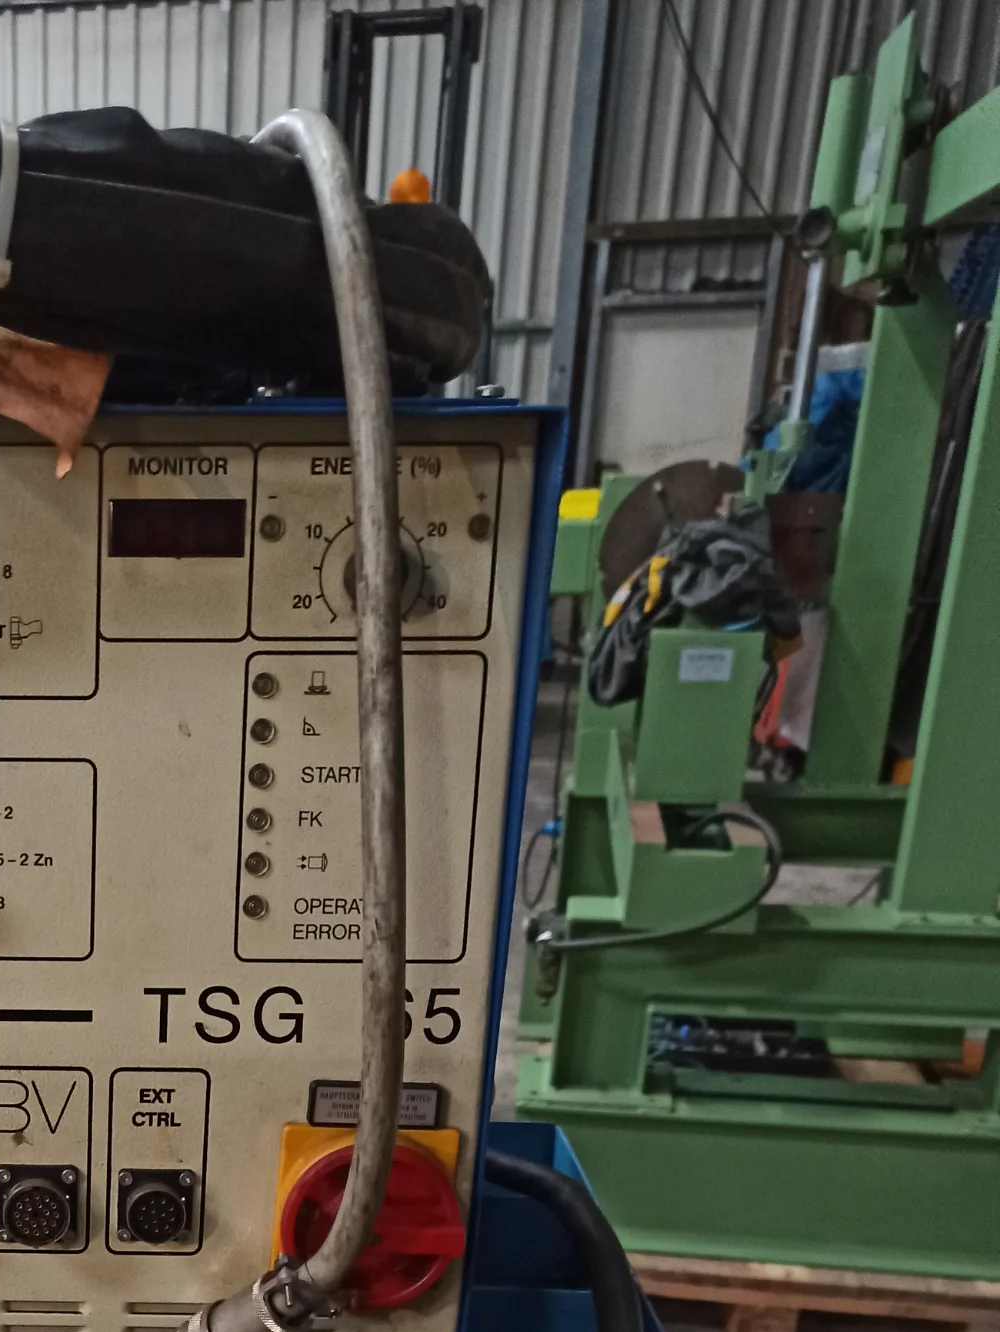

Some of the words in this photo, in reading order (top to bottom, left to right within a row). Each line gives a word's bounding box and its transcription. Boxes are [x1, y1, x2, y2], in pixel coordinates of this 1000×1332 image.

[128, 457, 228, 475] MONITOR
[305, 523, 323, 539] 10
[427, 522, 447, 537] 20
[292, 594, 312, 609] 20
[428, 595, 446, 609] 40
[301, 767, 361, 783] START
[298, 811, 323, 827] FK
[34, 854, 53, 867] Zn
[294, 898, 362, 915] OPERA
[292, 924, 361, 940] ERROR
[143, 985, 305, 1044] TSG
[139, 1088, 176, 1104] EXT
[132, 1112, 182, 1127] CTRL
